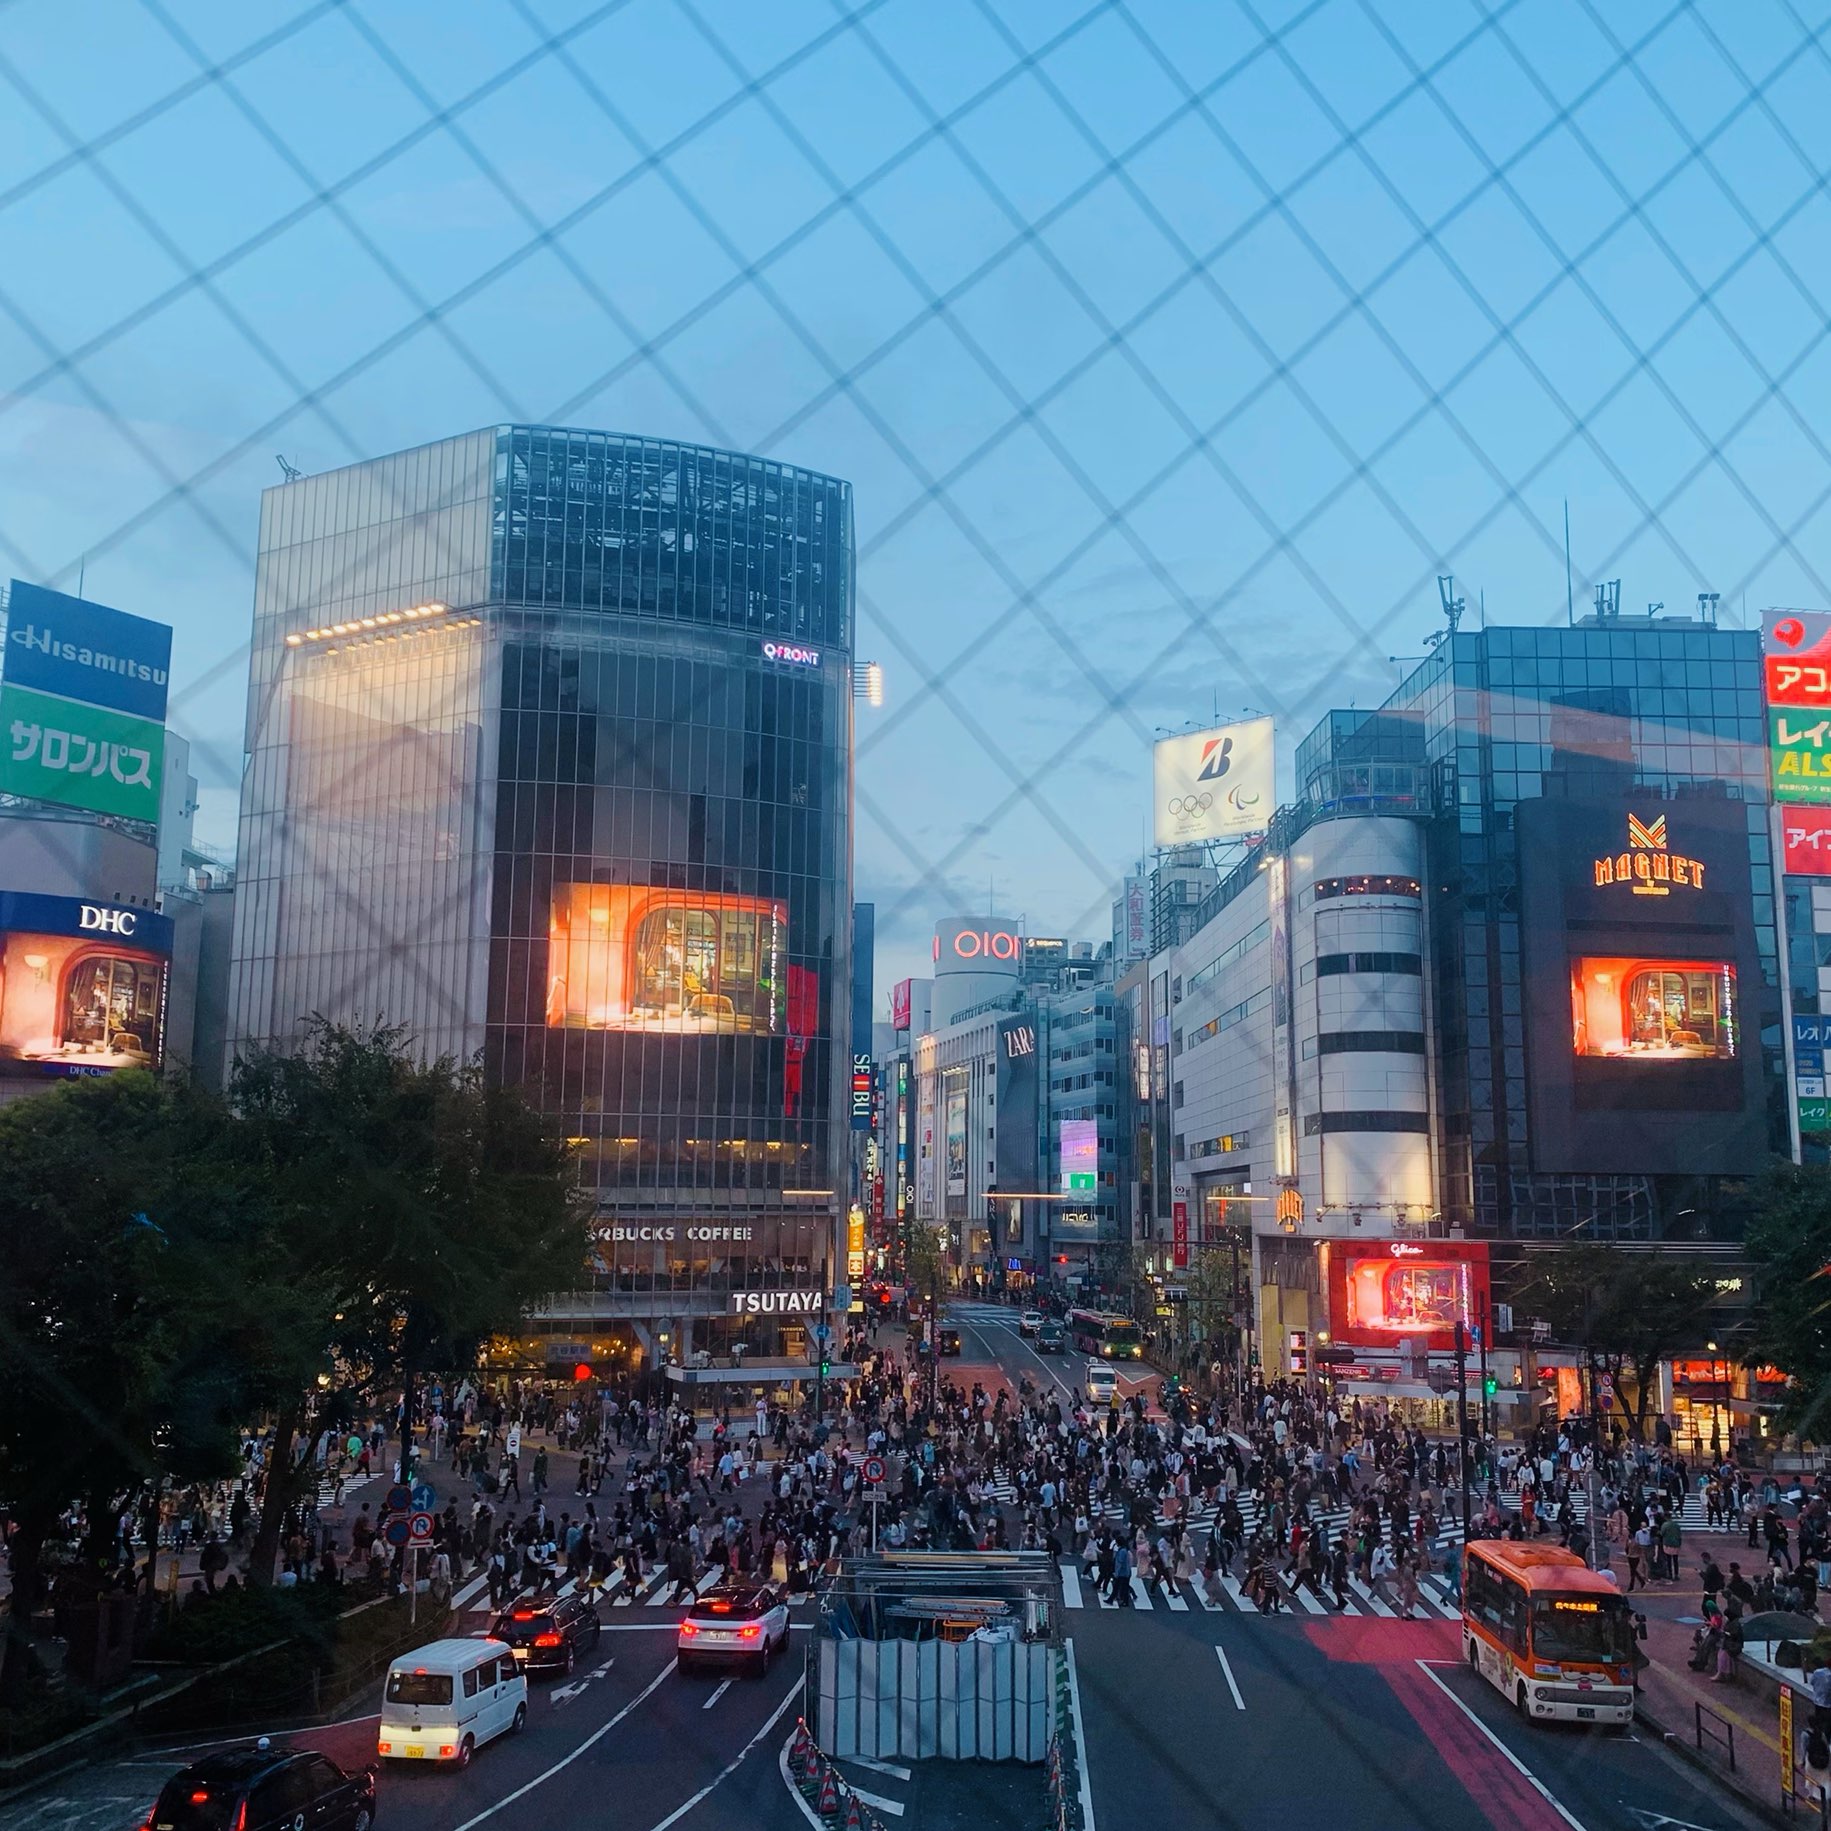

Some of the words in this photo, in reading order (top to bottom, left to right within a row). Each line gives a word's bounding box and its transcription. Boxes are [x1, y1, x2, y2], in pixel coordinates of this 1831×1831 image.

[10, 624, 168, 686] Hisamitsu
[1777, 666, 1831, 693] アコ
[1778, 718, 1831, 747] レイ
[10, 719, 152, 790] サロンパス
[1595, 852, 1705, 889] MAGNET
[79, 905, 137, 936] DHC
[1004, 1025, 1035, 1058] ZARA
[70, 1066, 90, 1076] DHC
[90, 1067, 112, 1077] Chan
[853, 1054, 870, 1117] SEIBU
[1800, 1107, 1825, 1117] レイク
[590, 1227, 675, 1241] RBUCKS
[687, 1227, 752, 1241] COFFEE
[1390, 1243, 1423, 1258] Glico
[733, 1292, 822, 1313] TSUTAYA
